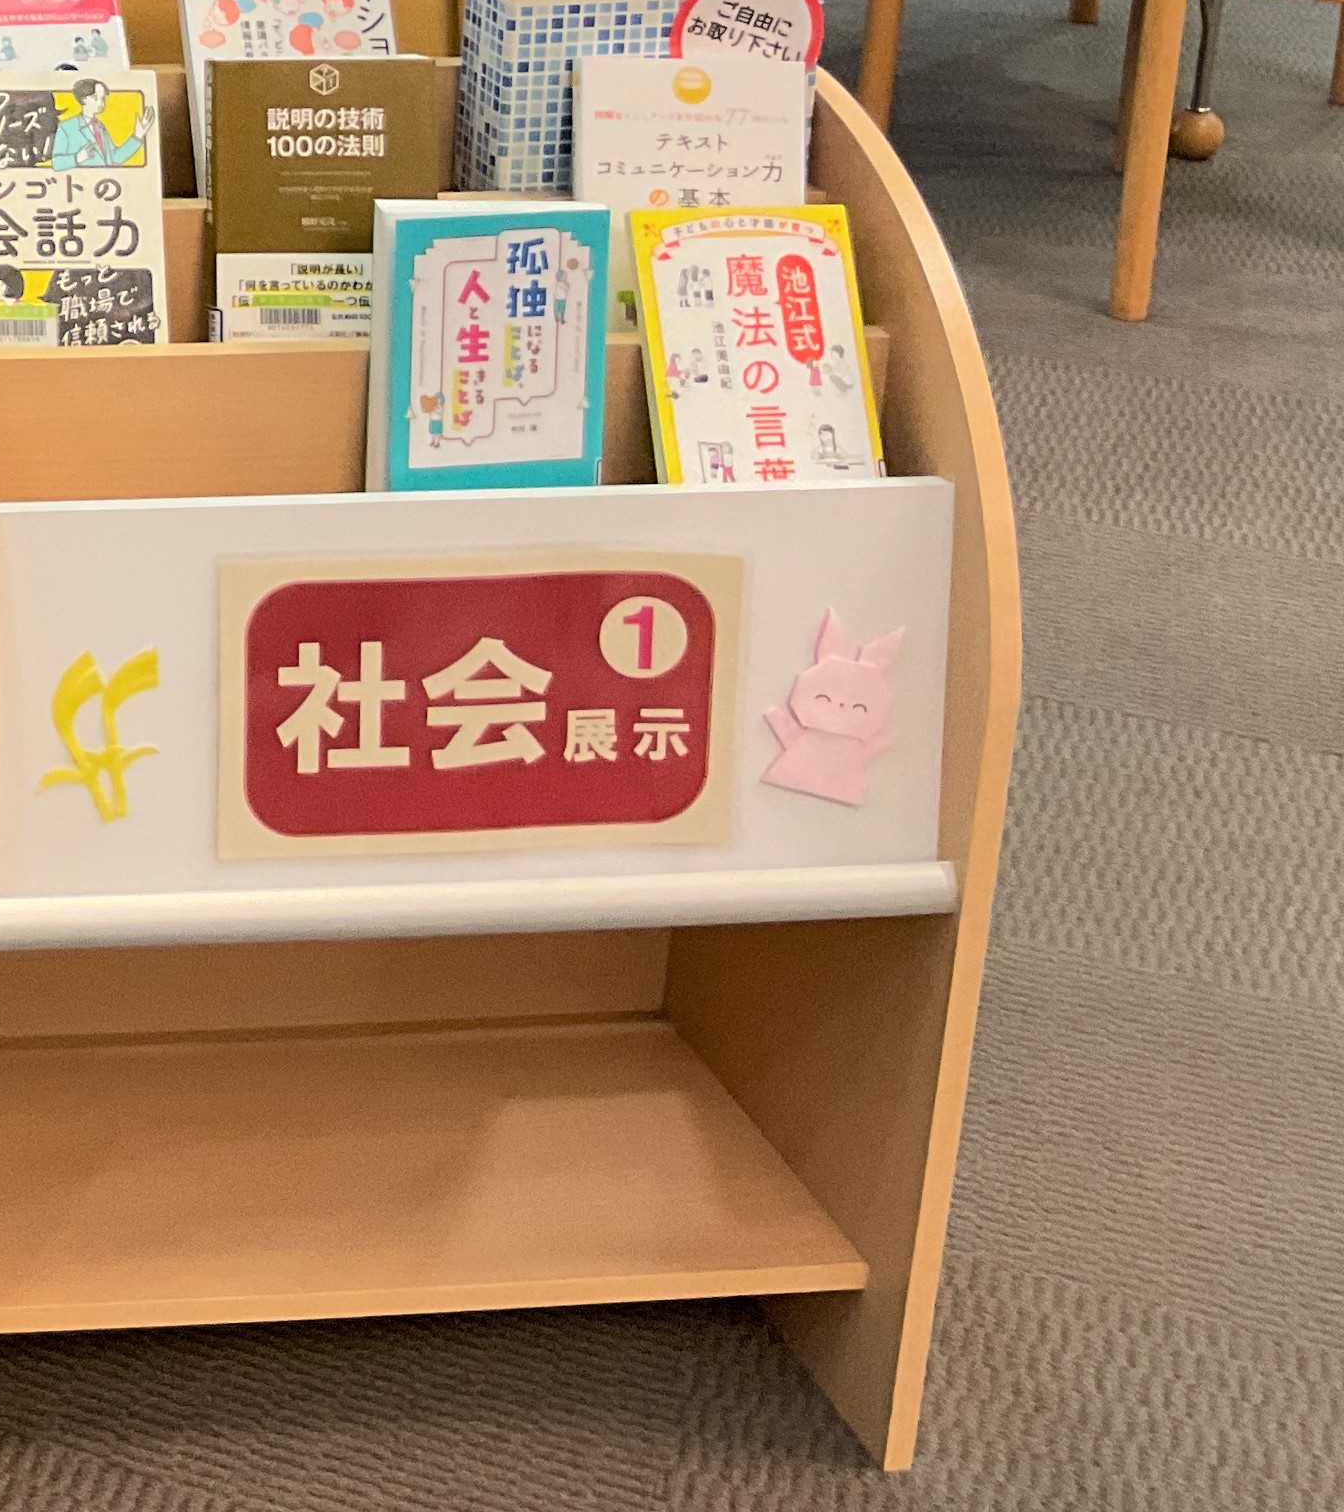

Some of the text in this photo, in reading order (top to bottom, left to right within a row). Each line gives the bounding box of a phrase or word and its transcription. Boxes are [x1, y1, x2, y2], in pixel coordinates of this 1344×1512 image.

[716, 0, 794, 38] ご自由に
[686, 15, 804, 62] お取り下さい
[266, 106, 386, 132] 説明の技術
[266, 133, 386, 158] 100の法則
[655, 132, 729, 154] テキスト
[596, 159, 784, 184] コミュニケーション力
[56, 263, 119, 292] もっと
[290, 262, 365, 277] 「説明が長い」
[505, 236, 550, 319] 孤独
[59, 286, 138, 322] 職場で
[780, 265, 821, 353] 池江式
[61, 311, 162, 347] 信頼される
